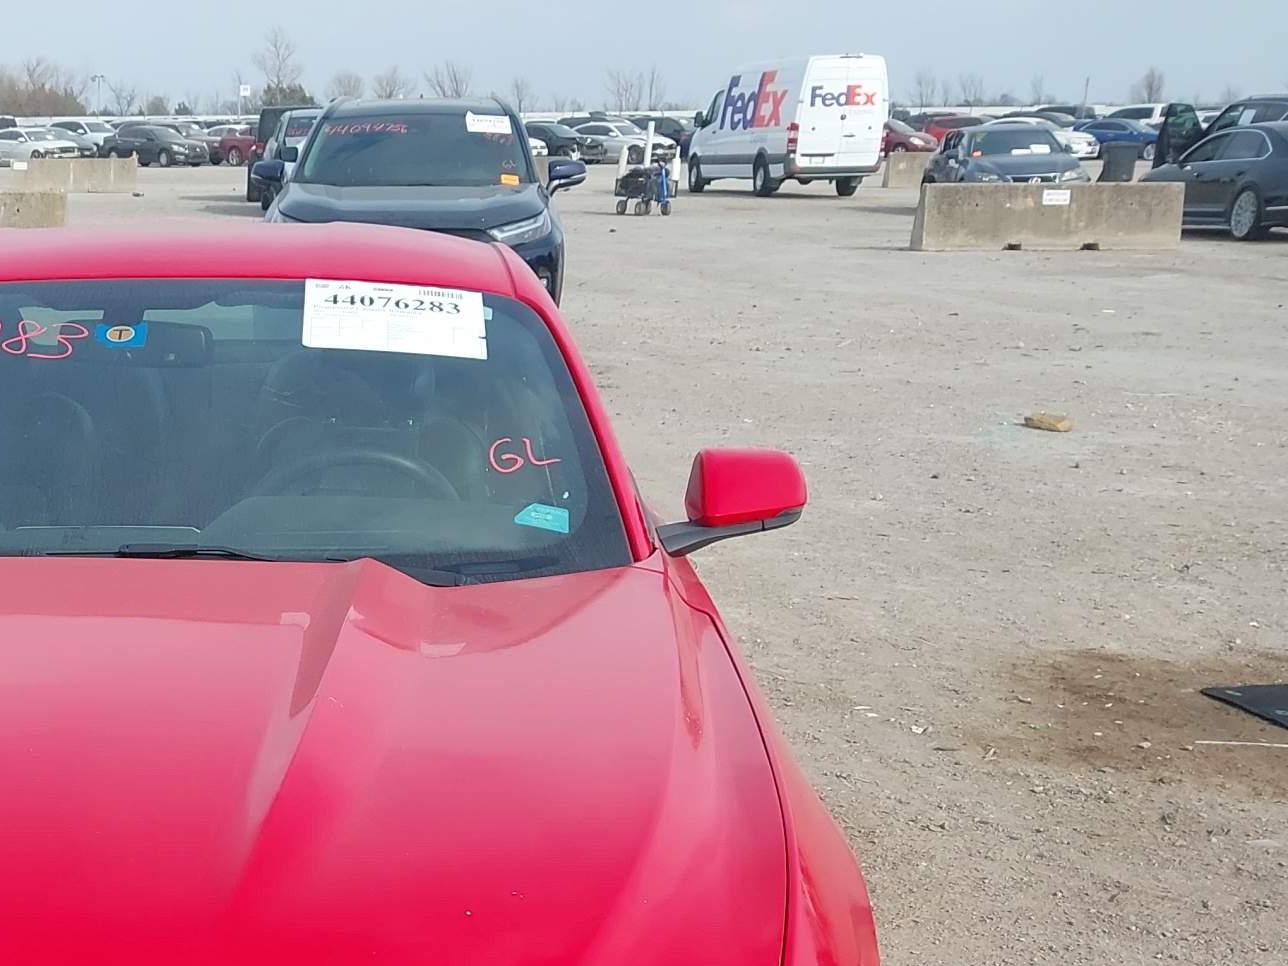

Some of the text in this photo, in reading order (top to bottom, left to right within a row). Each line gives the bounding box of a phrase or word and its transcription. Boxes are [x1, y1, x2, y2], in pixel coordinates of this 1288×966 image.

[720, 70, 788, 131] FedEx
[810, 85, 877, 107] FedEx
[324, 293, 461, 315] 44076283
[488, 437, 562, 473] GL
